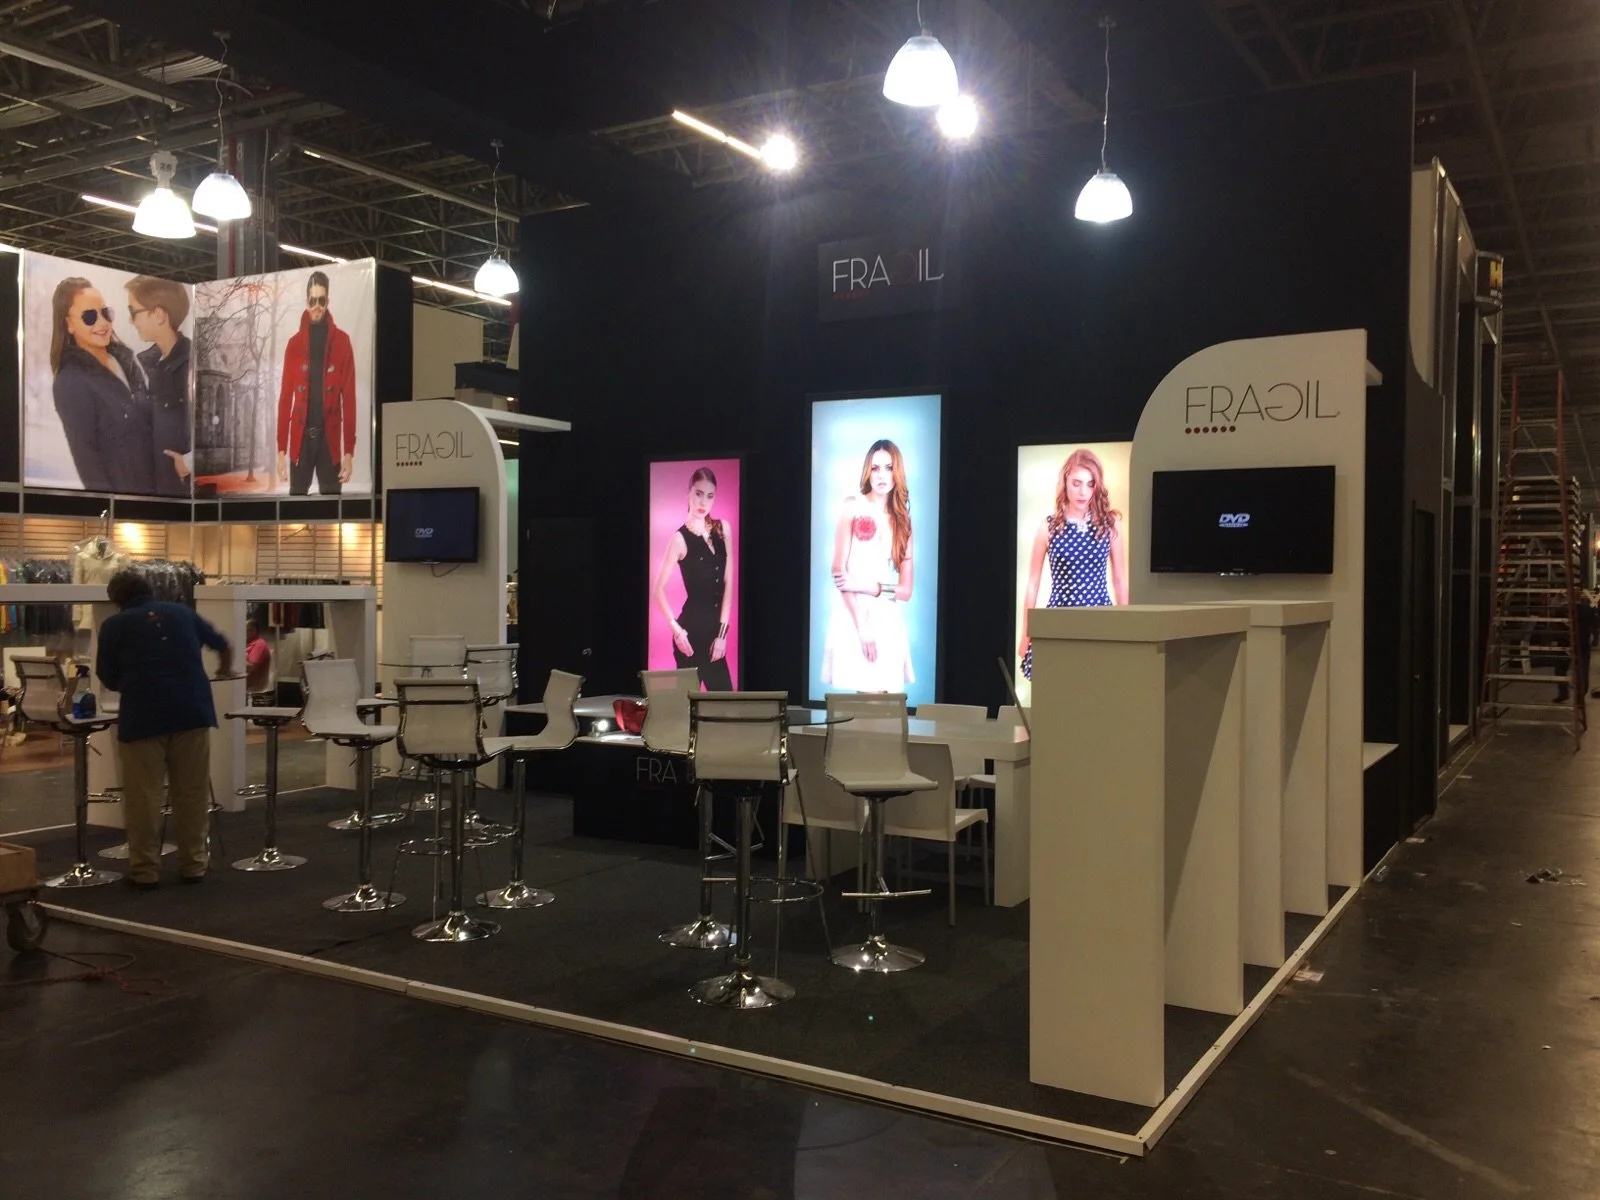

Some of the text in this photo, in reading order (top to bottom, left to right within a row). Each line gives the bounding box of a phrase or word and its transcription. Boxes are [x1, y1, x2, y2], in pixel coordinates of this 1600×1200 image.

[1185, 379, 1341, 424] FRAGIL
[395, 431, 475, 460] FRAGIL
[1219, 513, 1251, 524] DVD
[636, 756, 678, 785] FRA
